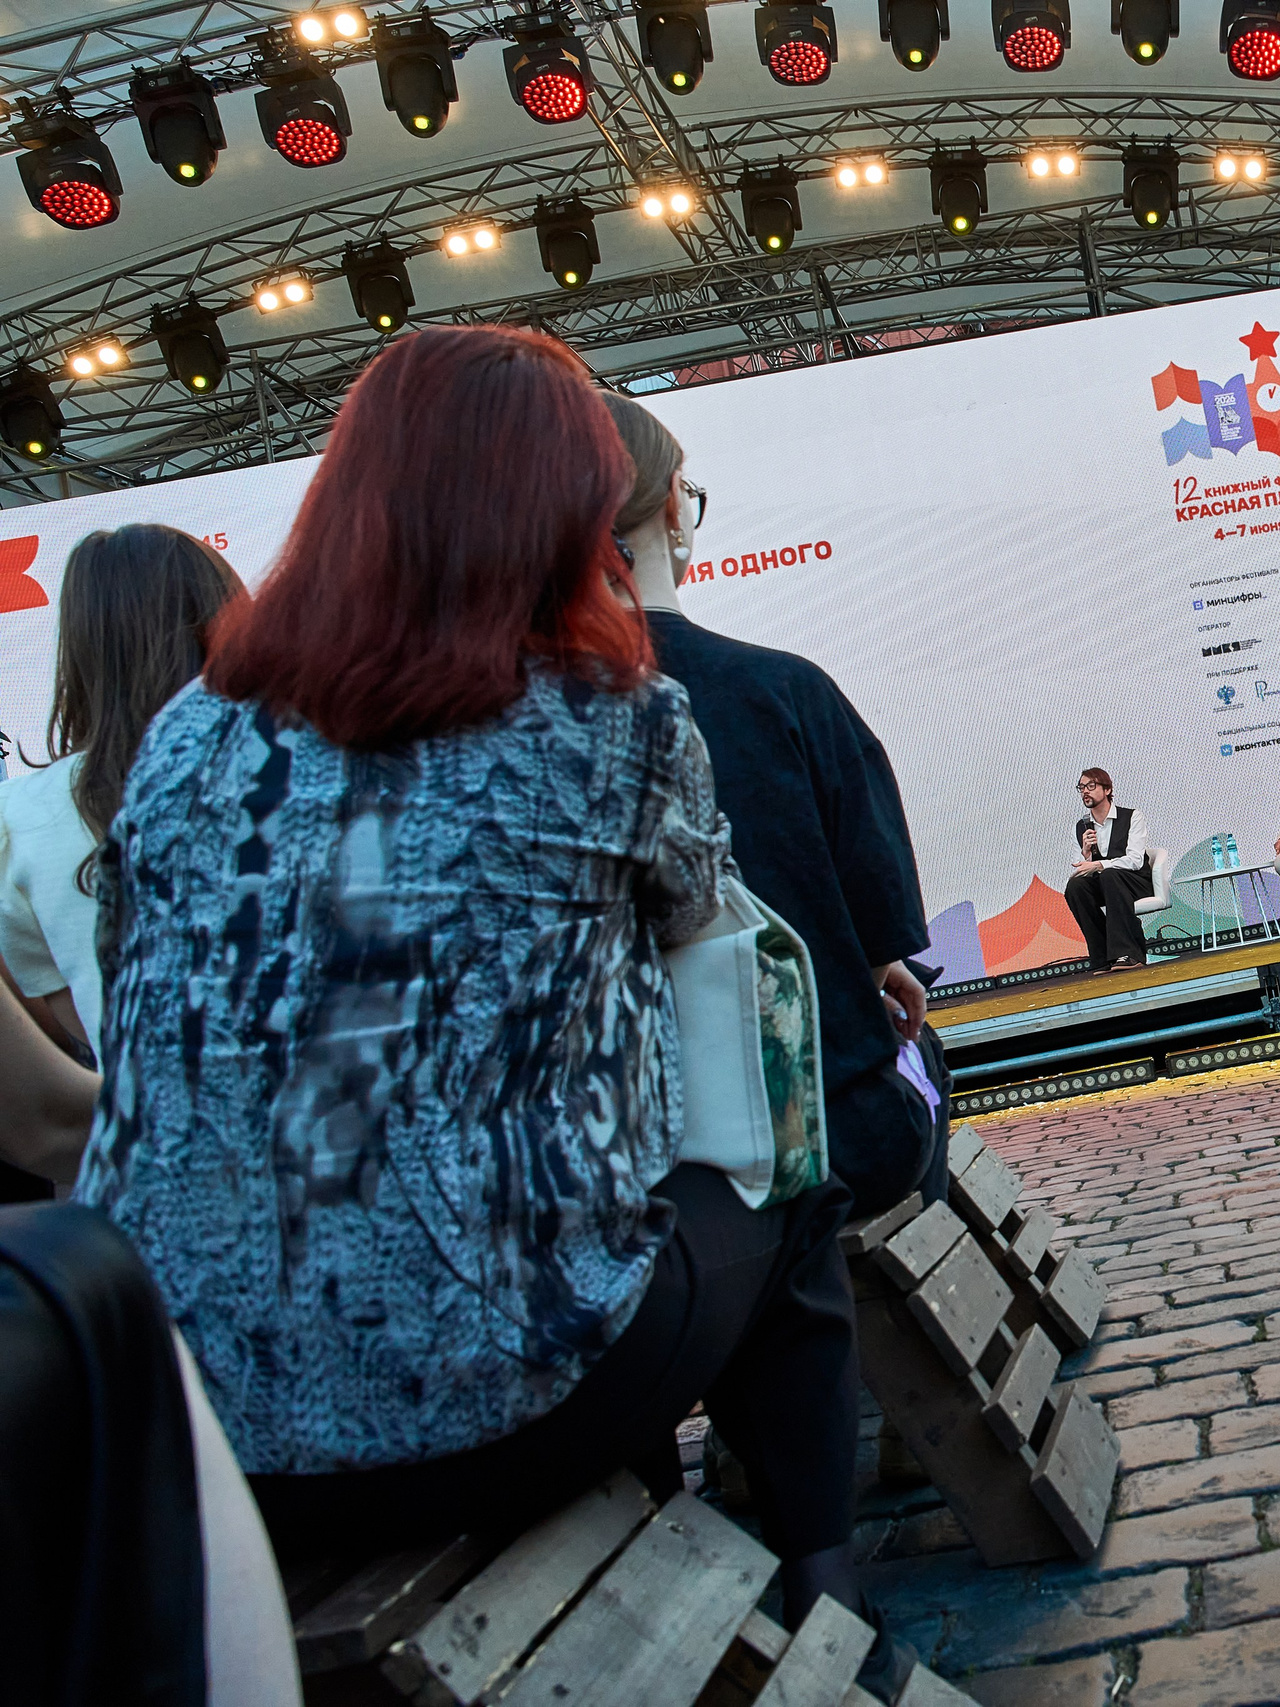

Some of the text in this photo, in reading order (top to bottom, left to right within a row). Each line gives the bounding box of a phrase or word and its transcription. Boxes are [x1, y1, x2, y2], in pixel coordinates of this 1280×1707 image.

[1173, 476, 1202, 505] 12
[1204, 476, 1271, 498] КНИЖНЫЙ
[1175, 495, 1260, 522] КРАСНАЯ
[721, 540, 833, 577] ОДНОГО
[1189, 568, 1279, 589] ОРГАНИЗАТОРЫ ФЕСТИВАЛЯ
[1198, 621, 1231, 633] ОПЕРАТОР
[1221, 664, 1259, 676] ПОДДЕРЖКЕ
[1217, 723, 1266, 737] ОФИЦИАЛЬНАЯ
